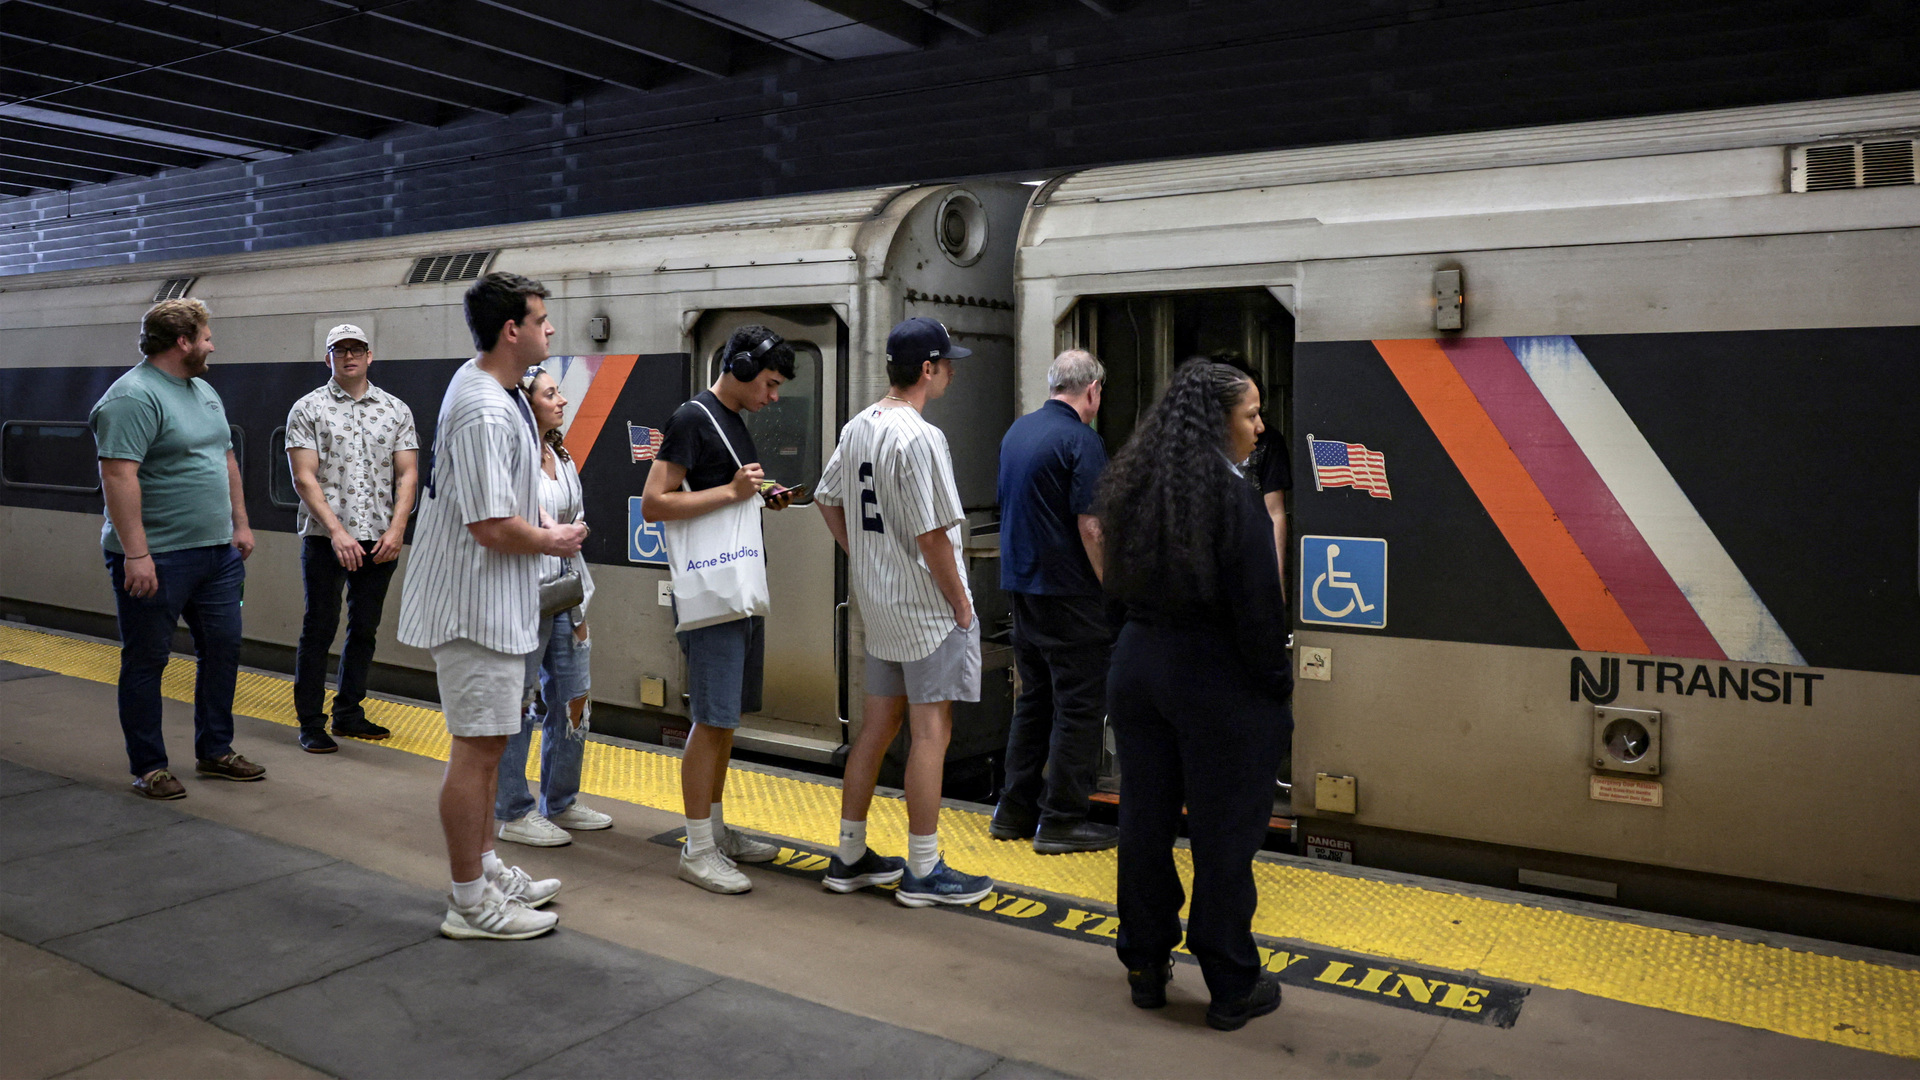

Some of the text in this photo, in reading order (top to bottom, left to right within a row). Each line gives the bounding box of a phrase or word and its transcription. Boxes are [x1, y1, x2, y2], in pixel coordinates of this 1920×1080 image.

[858, 462, 884, 534] 2
[686, 546, 759, 572] Acne Studios
[1570, 656, 1825, 707] NJ TRANSIT
[1308, 835, 1351, 850] DANGER
[1329, 849, 1344, 858] NOT
[1313, 961, 1490, 1014] LINE
